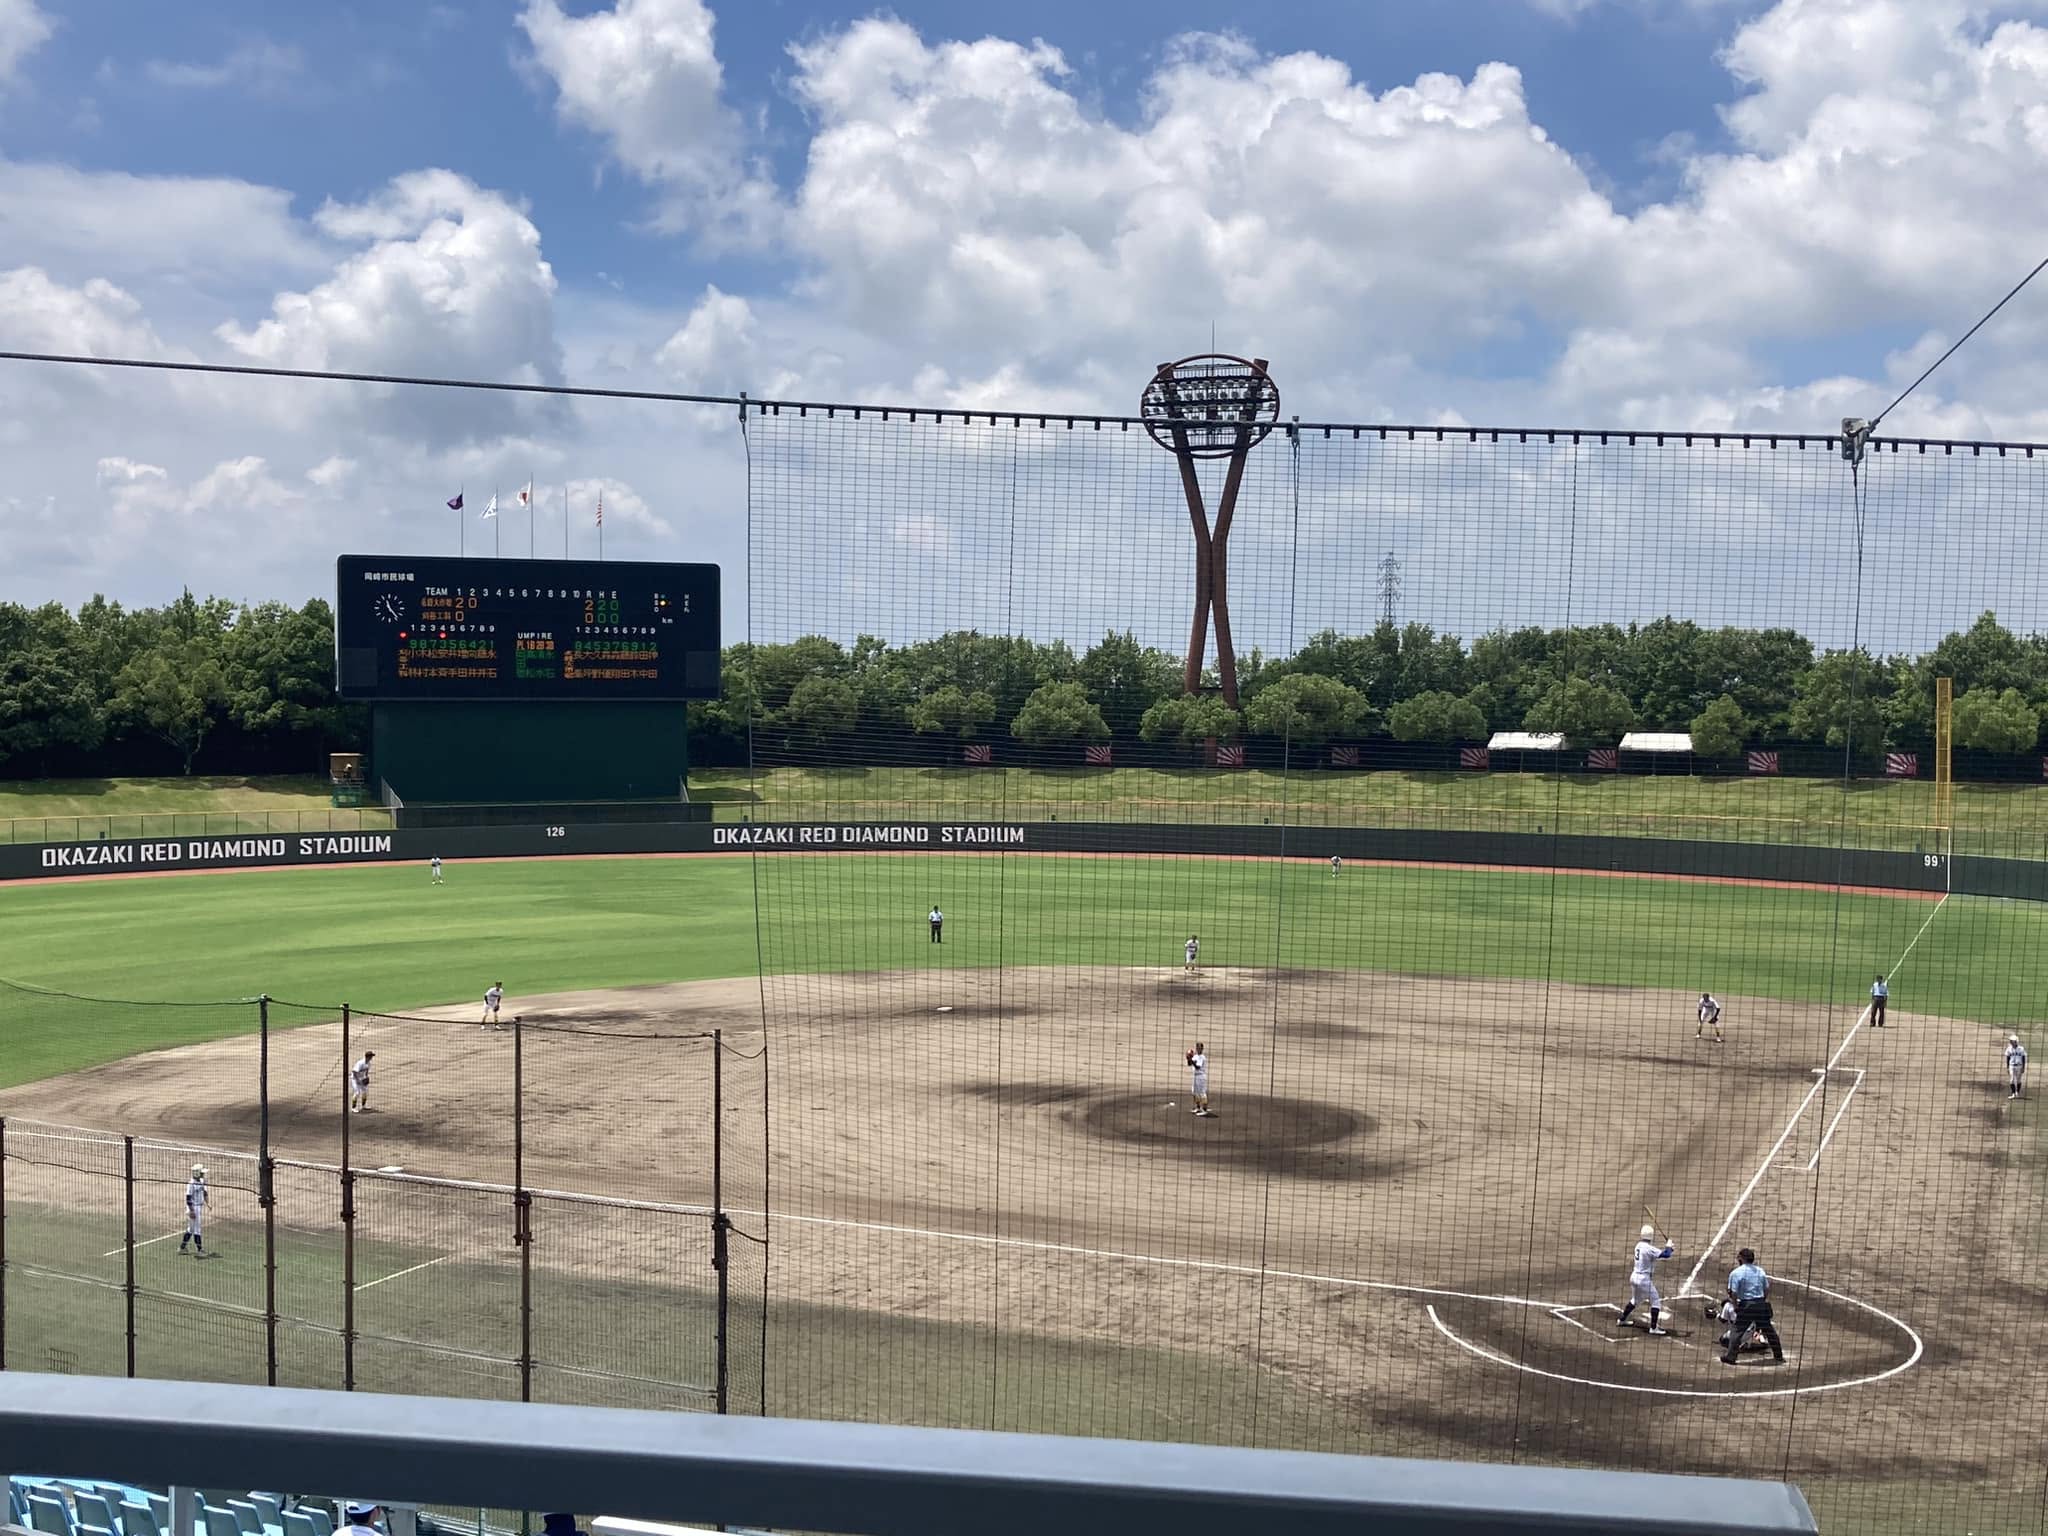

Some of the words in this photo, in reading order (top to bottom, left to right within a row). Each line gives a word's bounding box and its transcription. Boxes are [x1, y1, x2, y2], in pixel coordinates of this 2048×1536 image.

[425, 587, 448, 596] TEAM
[546, 826, 565, 837] 126
[712, 827, 794, 844] OKAZAKI
[799, 827, 836, 843] RED
[842, 827, 929, 843] DIAMOND
[941, 827, 1024, 843] STADIUM
[42, 845, 133, 867] OKAZAKI
[140, 842, 182, 862] RED
[188, 839, 286, 860] DIAMOND
[300, 836, 392, 855] STADIUM
